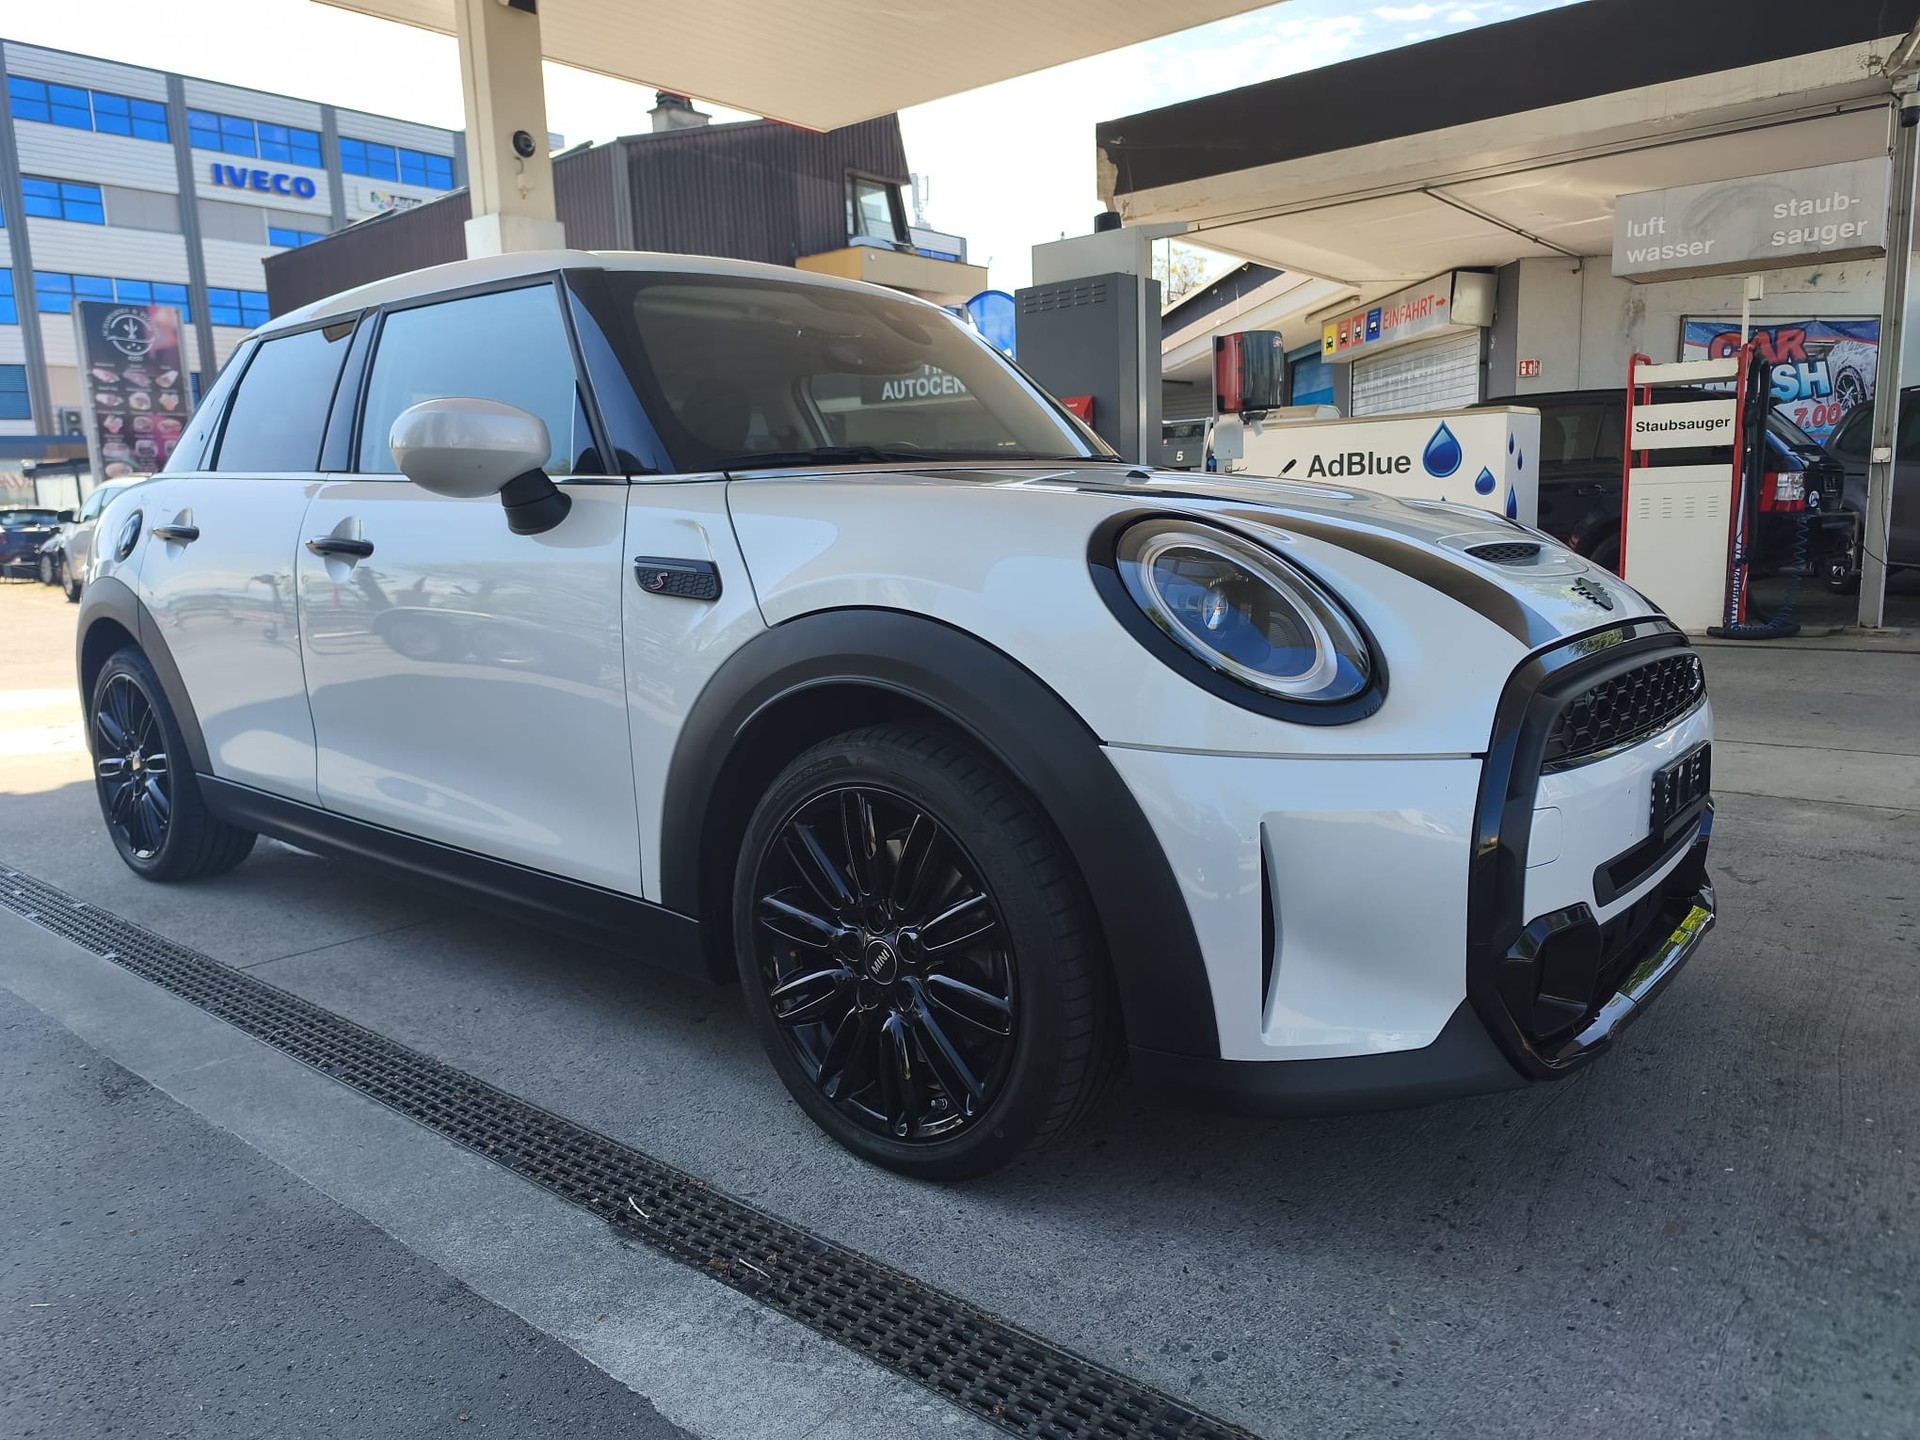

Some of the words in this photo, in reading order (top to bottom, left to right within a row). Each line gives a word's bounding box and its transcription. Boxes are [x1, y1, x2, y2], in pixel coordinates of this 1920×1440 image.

[212, 163, 316, 200] IVECO
[1772, 191, 1861, 219] staub-
[1626, 215, 1667, 238] luft
[1771, 217, 1868, 248] sauger
[1626, 237, 1716, 264] wasser
[1382, 295, 1435, 330] EINFAHRT
[1708, 329, 1807, 365] CAR
[1635, 416, 1731, 433] Staubsauger
[1793, 402, 1843, 429] 7.00
[1175, 451, 1185, 462] 5
[1307, 451, 1412, 478] AdBlue
[650, 572, 669, 590] S
[870, 948, 890, 975] MINI
